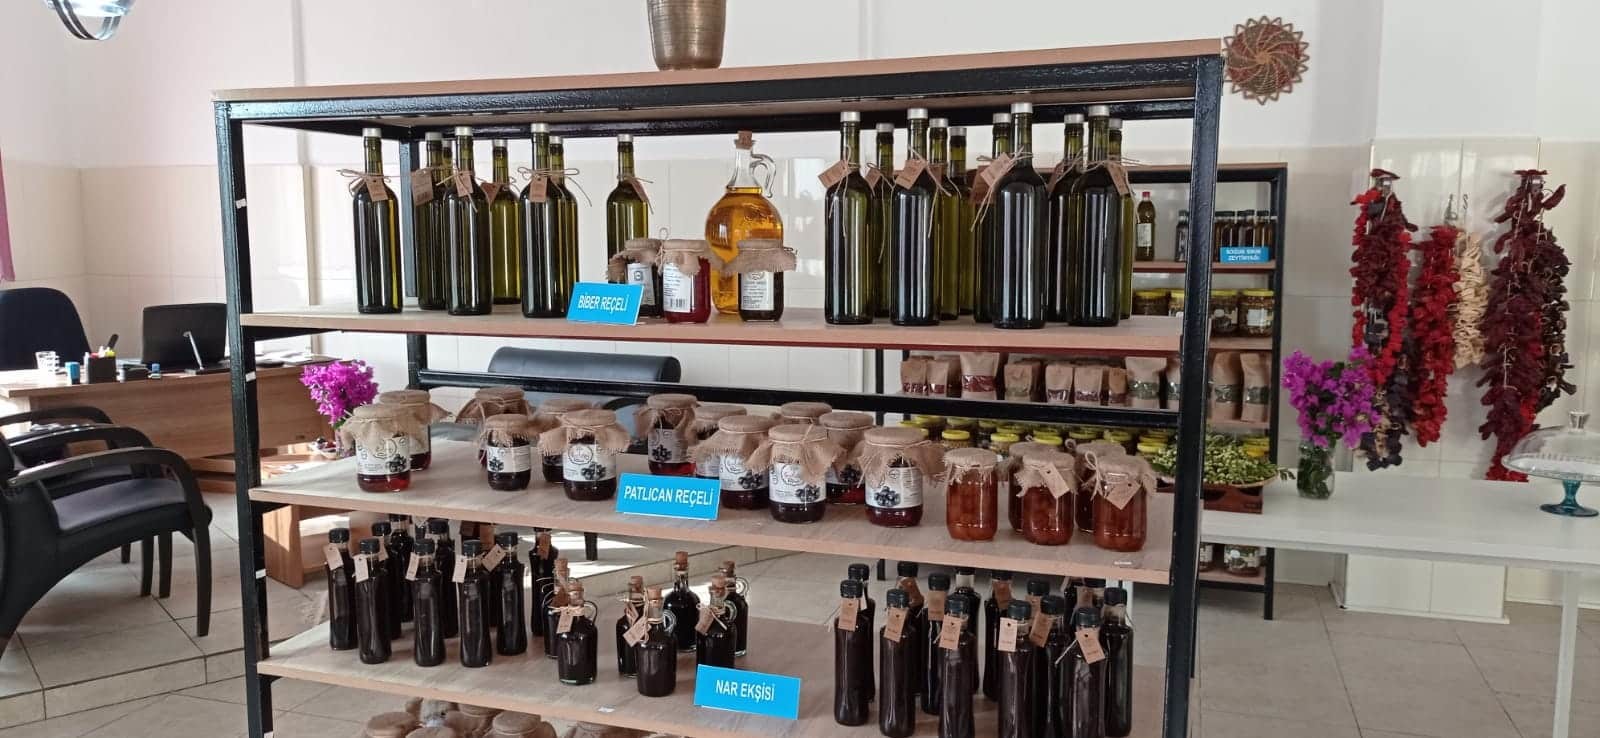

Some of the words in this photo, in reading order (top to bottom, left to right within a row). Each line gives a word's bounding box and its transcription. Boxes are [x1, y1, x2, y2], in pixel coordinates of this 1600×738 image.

[578, 292, 600, 309] BİBER
[601, 293, 629, 314] REÇELİ
[623, 485, 673, 503] PATLICAN
[675, 488, 714, 508] REÇELİ
[716, 679, 738, 697] NAR
[740, 682, 775, 703] EKŞİSİ
